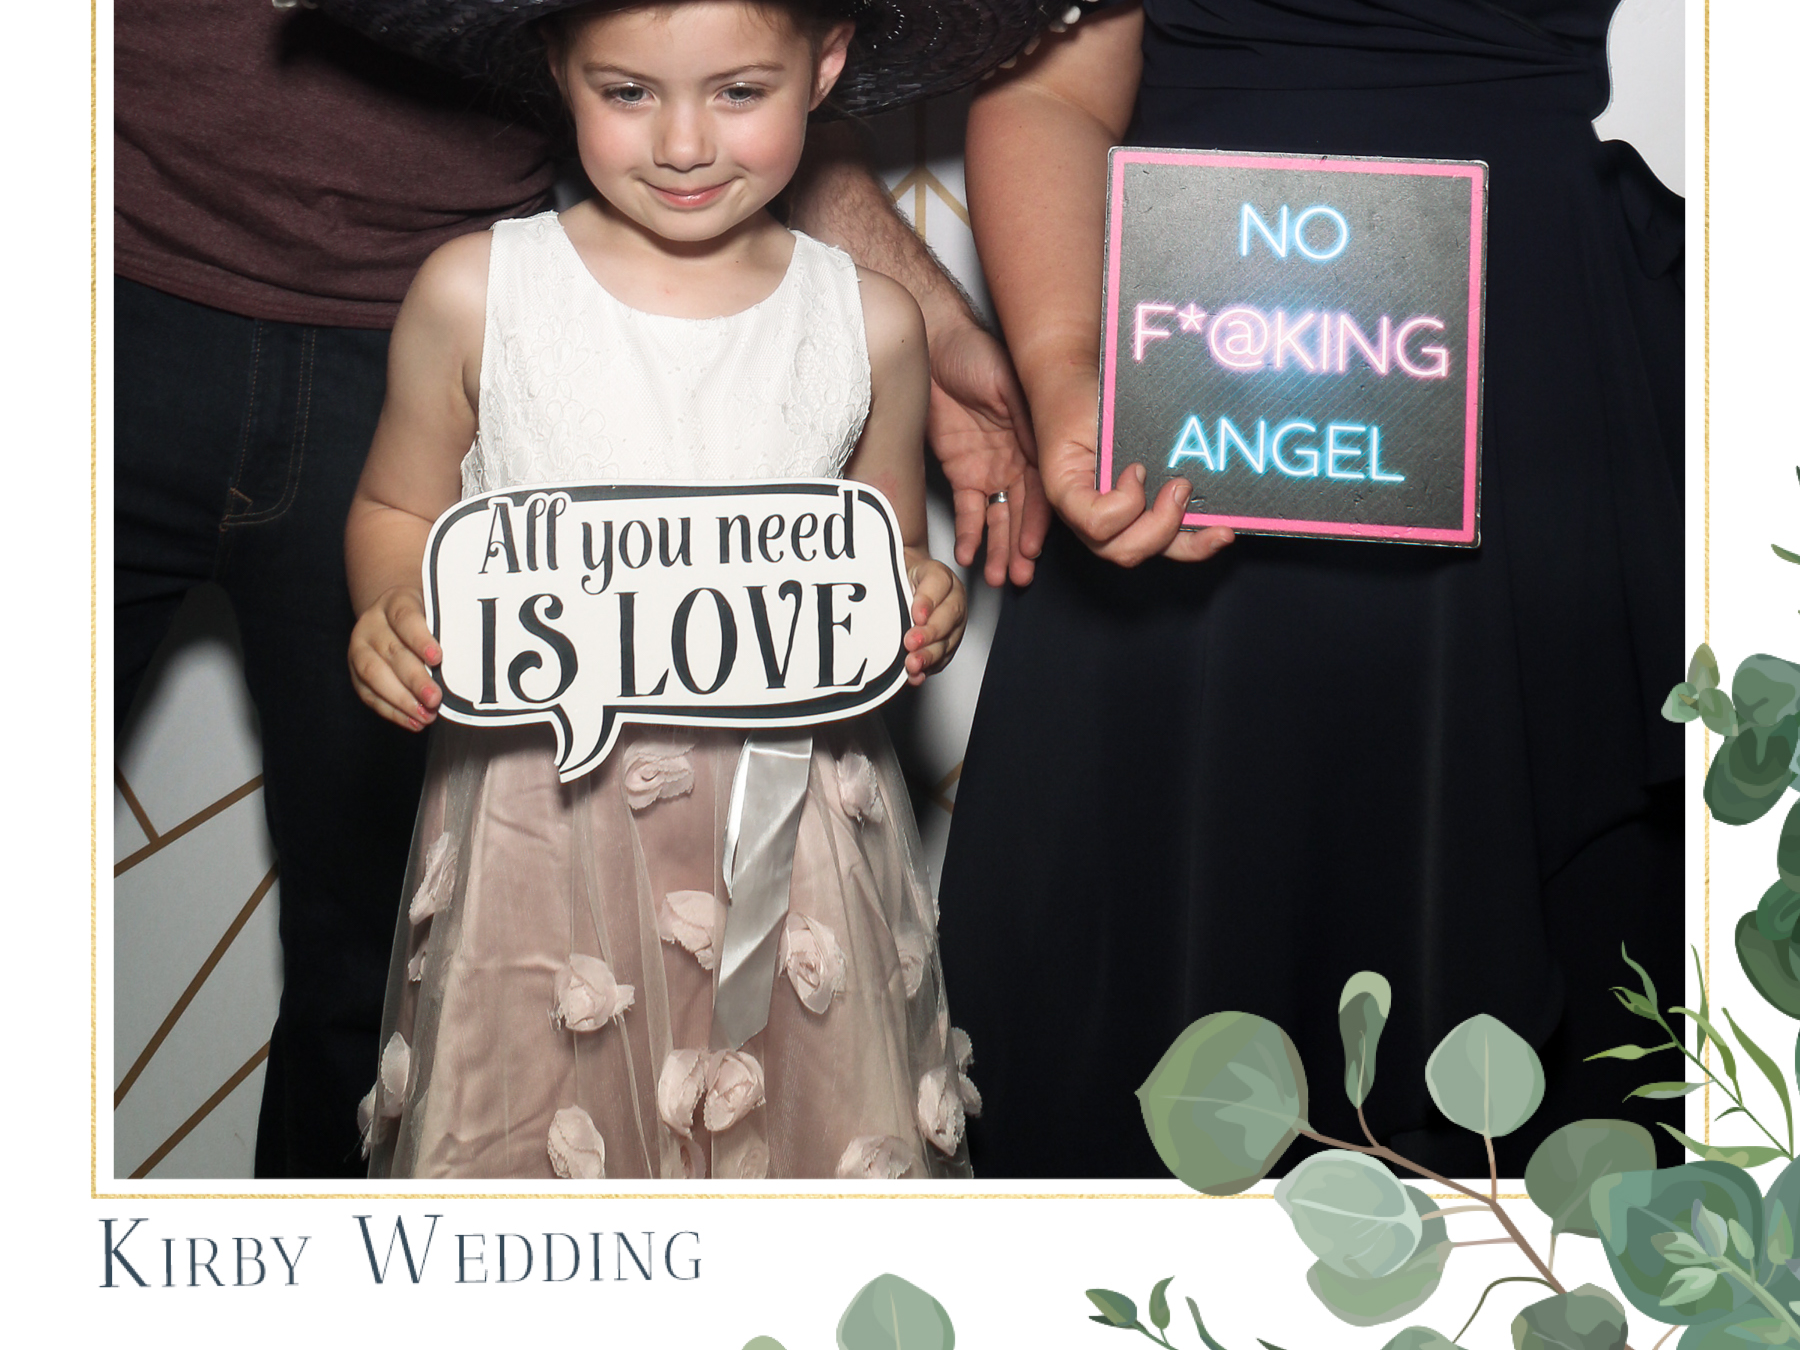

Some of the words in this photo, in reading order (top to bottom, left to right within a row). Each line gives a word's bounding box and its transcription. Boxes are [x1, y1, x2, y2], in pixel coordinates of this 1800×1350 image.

[1240, 203, 1349, 261] NO
[1167, 414, 1406, 482] ANGEL
[478, 497, 566, 574] All
[581, 516, 692, 595] you
[716, 489, 857, 565] need
[477, 593, 578, 705] IS
[614, 579, 868, 698] LOVE
